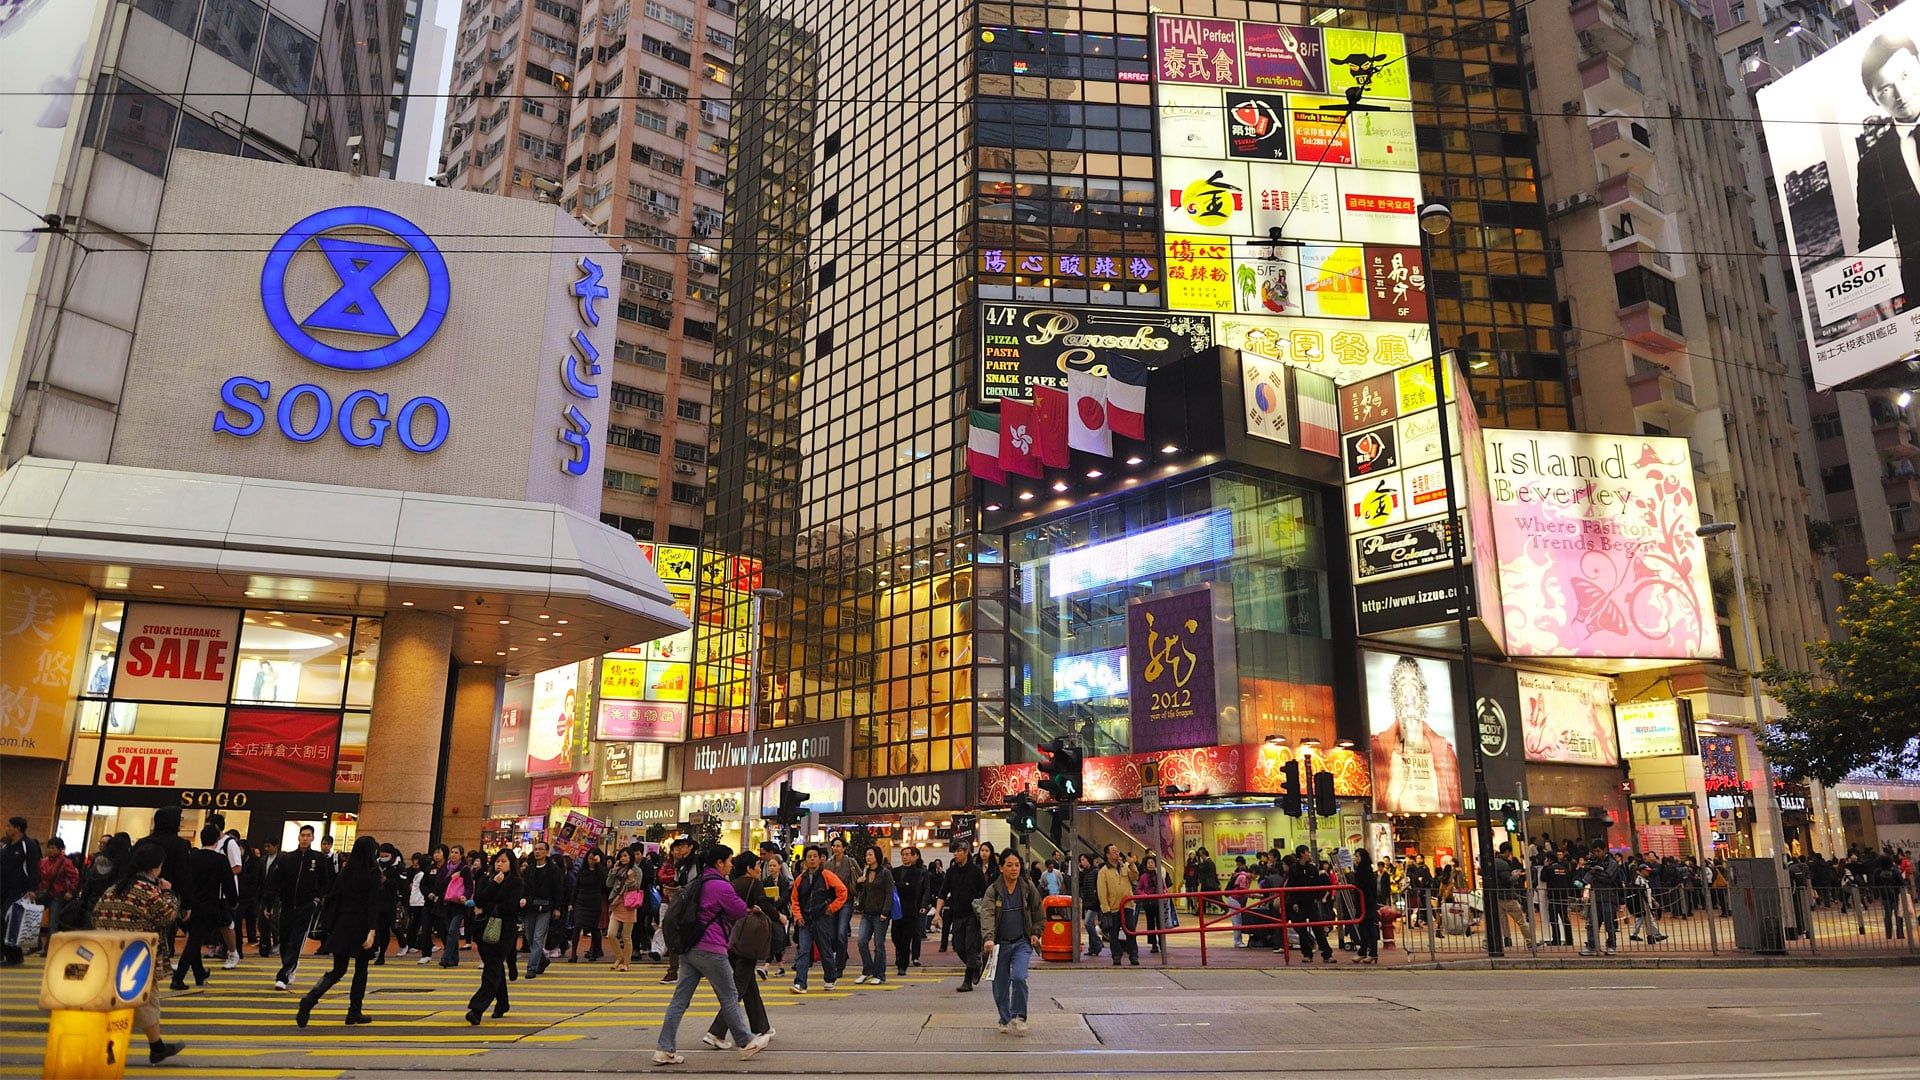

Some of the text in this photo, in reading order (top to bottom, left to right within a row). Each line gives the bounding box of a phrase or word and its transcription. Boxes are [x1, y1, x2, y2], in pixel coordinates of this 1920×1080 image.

[1160, 18, 1202, 46] THAI
[1203, 28, 1235, 44] Perfect
[1300, 42, 1319, 57] 8/F
[1164, 46, 1233, 83] 泰式食
[1118, 72, 1149, 81] PERFECT
[1257, 265, 1277, 276] 5/F
[1825, 264, 1886, 299] TISSOT
[986, 307, 1017, 326] 4/F
[1398, 307, 1410, 316] 5F
[1022, 309, 1170, 351] Pancake
[986, 336, 1019, 345] PIZZA
[986, 348, 1019, 358] PASTA
[558, 256, 608, 476] そごう
[986, 361, 1019, 371] PARTY
[986, 374, 1019, 384] SNACK
[1024, 376, 1056, 387] CAFE
[986, 386, 1019, 397] COCKTAIL
[213, 376, 450, 455] SOGO
[1490, 440, 1629, 480] Island
[1494, 479, 1632, 516] Beverley
[1516, 516, 1653, 538] Where Fashion
[1528, 534, 1594, 552] Trends
[2, 584, 58, 641] 美
[143, 624, 221, 638] STOCK CLEARANCE
[126, 636, 228, 681] SALE
[1150, 689, 1192, 711] 2012
[1262, 713, 1316, 724] Hiroshima
[1482, 714, 1496, 724] THE
[1480, 724, 1501, 735] BODY
[0, 736, 36, 749] om.hk
[1481, 735, 1501, 745] SHOP
[117, 746, 173, 756] STOCK CLEARANCE
[230, 741, 331, 760] 全店清倉大割引
[694, 736, 830, 775] http://www.izzue.com
[105, 755, 178, 786] SALE
[181, 791, 248, 808] SOGO
[866, 780, 941, 808] bauhaus
[1462, 797, 1476, 810] TH
[1781, 797, 1806, 810] BALLY
[636, 808, 675, 820] GIORDANO
